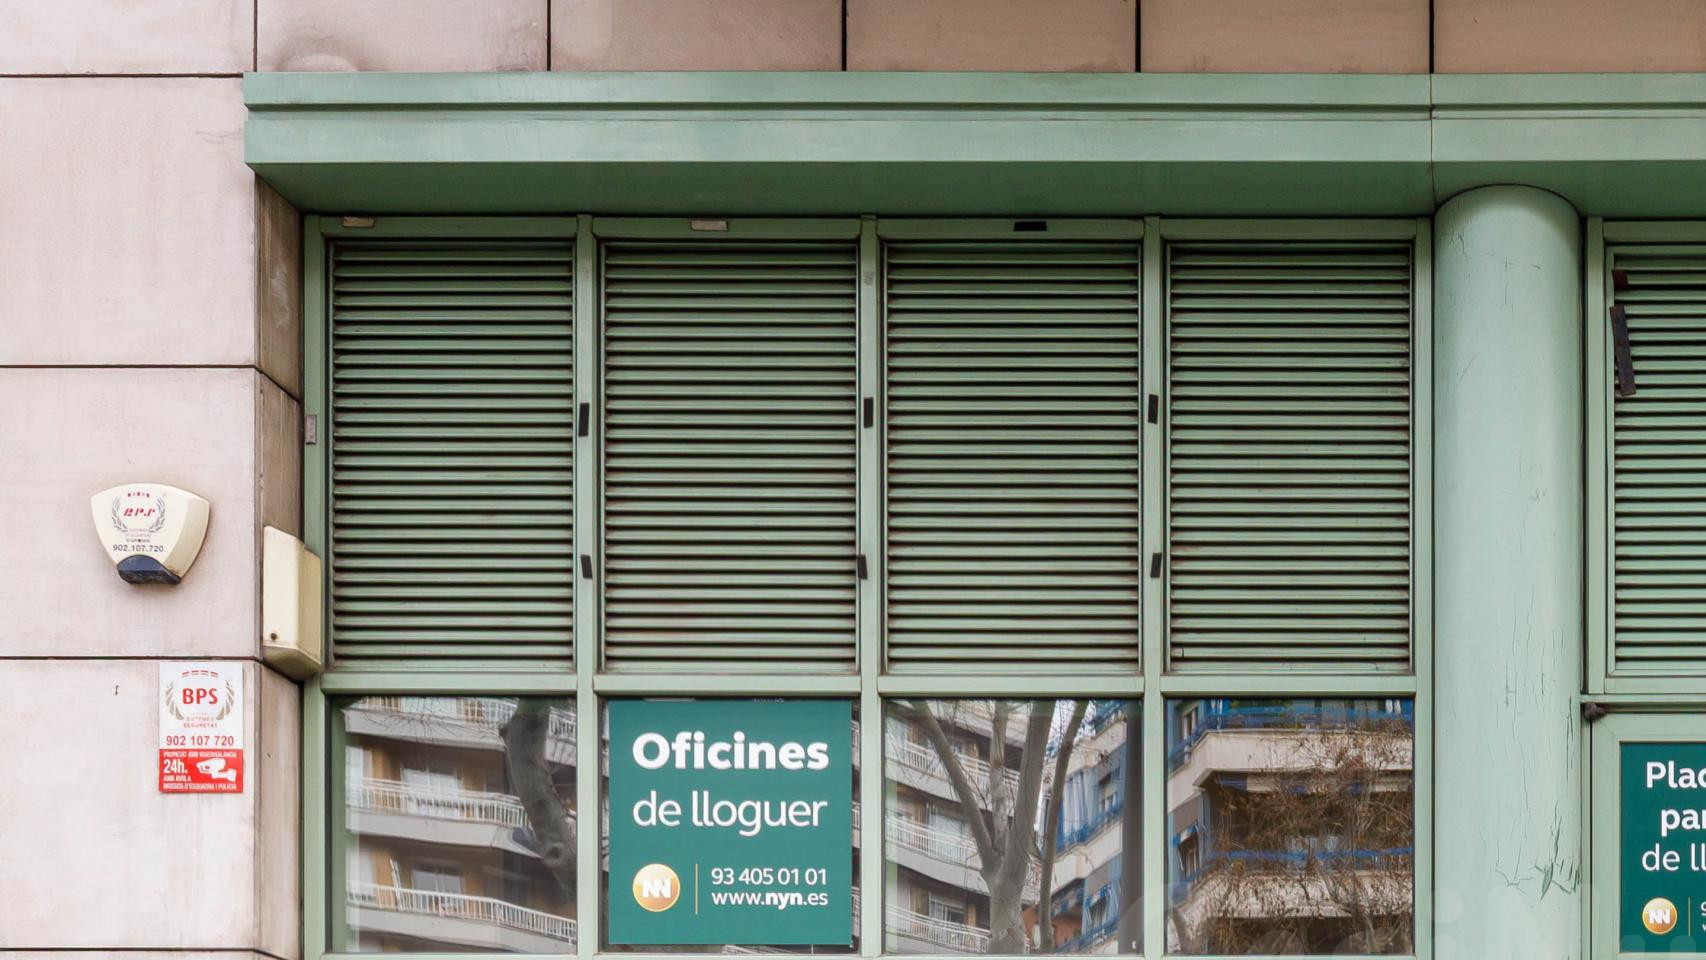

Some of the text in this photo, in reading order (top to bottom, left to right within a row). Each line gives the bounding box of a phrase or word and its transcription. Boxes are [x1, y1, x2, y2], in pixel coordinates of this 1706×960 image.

[113, 544, 164, 552] 902.107.720
[182, 688, 218, 704] BPS
[166, 736, 234, 745] 902 107 720
[632, 730, 830, 770] Oficines
[163, 759, 188, 773] 24h.
[632, 790, 828, 837] de lloguer
[1642, 843, 1680, 871] de
[711, 867, 827, 885] 93 405 01 01
[711, 891, 828, 910] www.nyn.es
